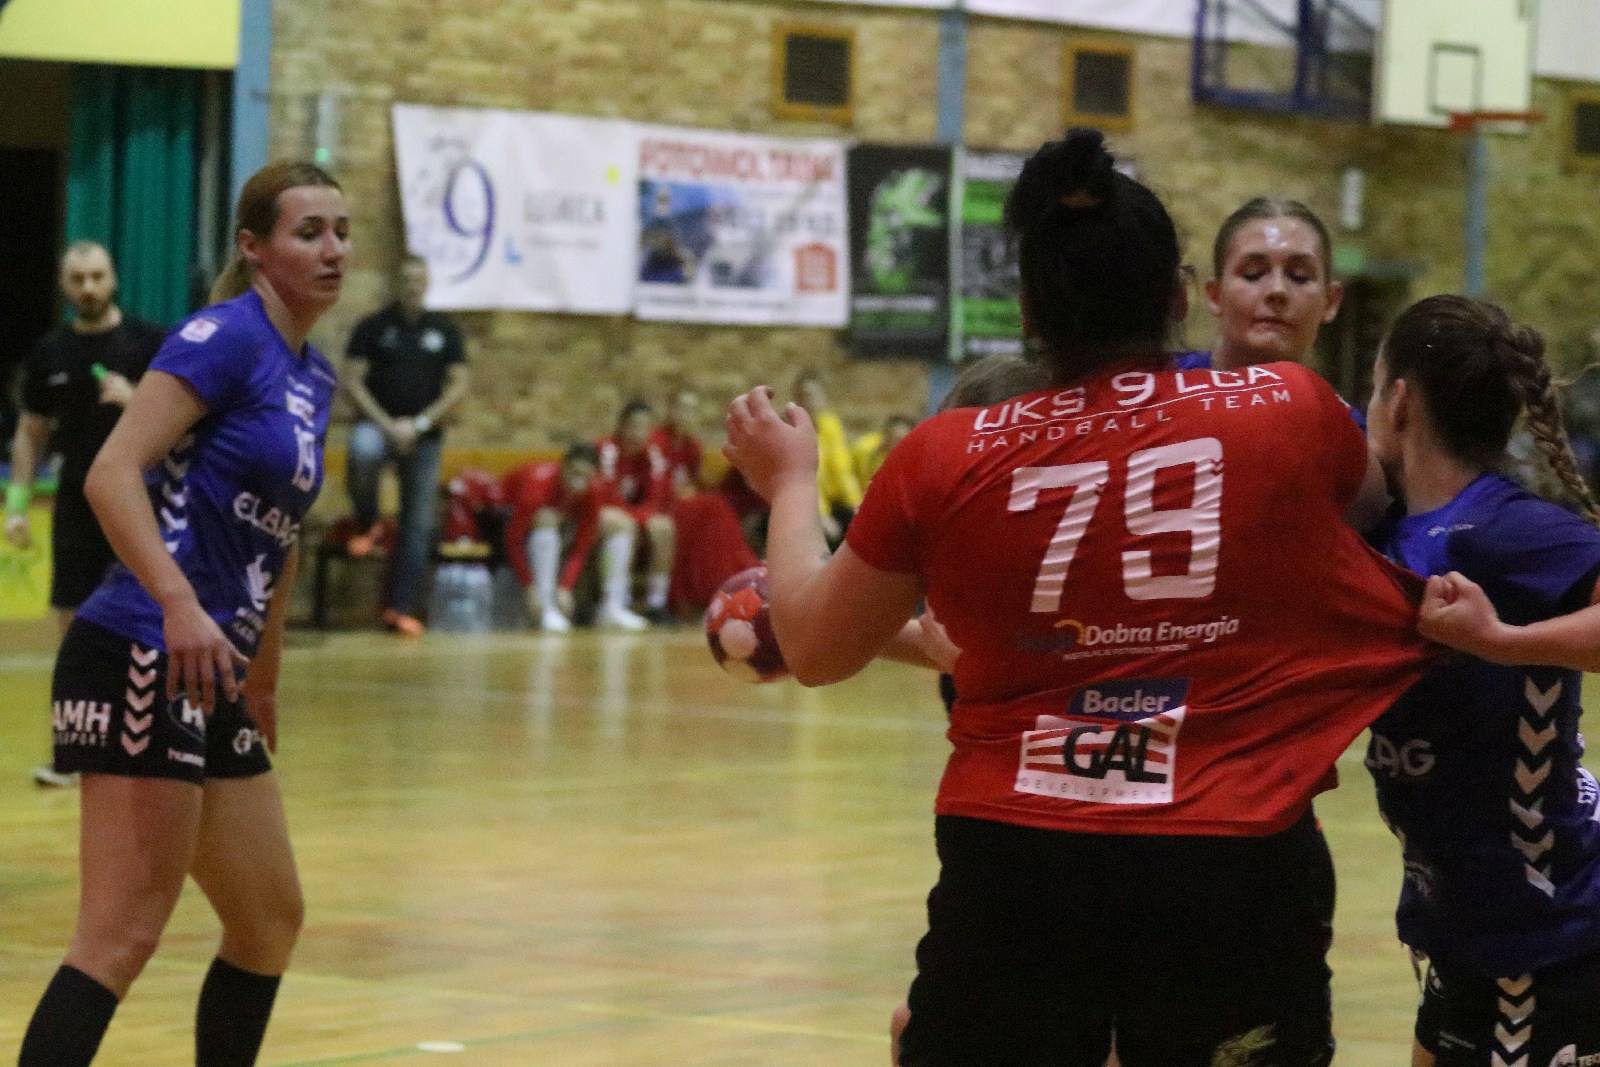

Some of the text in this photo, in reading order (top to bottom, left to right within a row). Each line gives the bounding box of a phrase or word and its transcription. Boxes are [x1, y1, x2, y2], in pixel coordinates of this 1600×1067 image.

[966, 389, 1292, 454] HANDBALL TEAM
[973, 386, 1087, 431] UKS
[1111, 371, 1156, 407] 9
[1006, 436, 1225, 613] 79
[1084, 623, 1152, 646] Dobra
[1156, 615, 1240, 643] Energia
[1064, 724, 1168, 784] GAL
[1020, 777, 1169, 798] DEVELOPMENT
